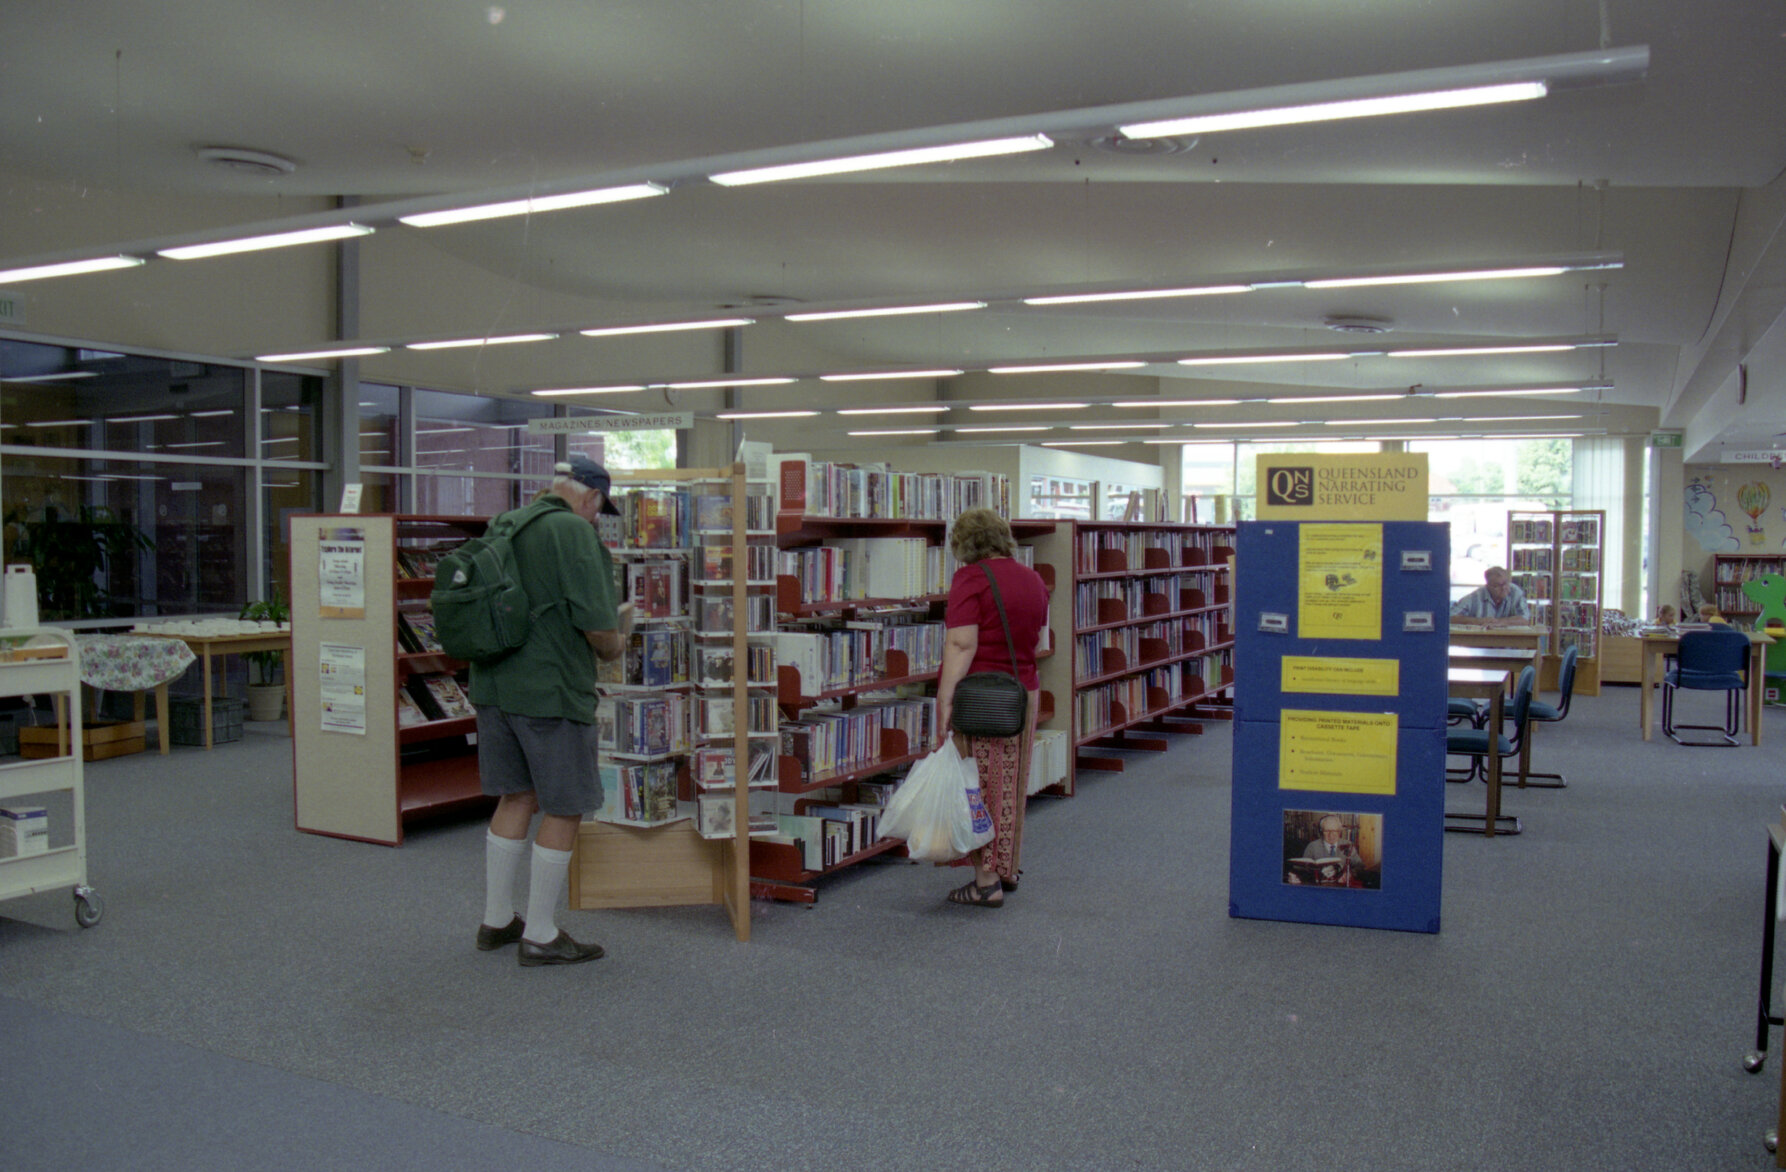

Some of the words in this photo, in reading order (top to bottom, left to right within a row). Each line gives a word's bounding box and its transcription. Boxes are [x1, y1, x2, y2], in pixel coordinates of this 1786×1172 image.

[540, 420, 600, 431] MAGAZINES
[606, 415, 682, 428] NEWSPAPERS
[1318, 467, 1418, 481] QUEENSLAND
[1318, 481, 1406, 493] NARRATING
[1318, 493, 1376, 505] SERVICE
